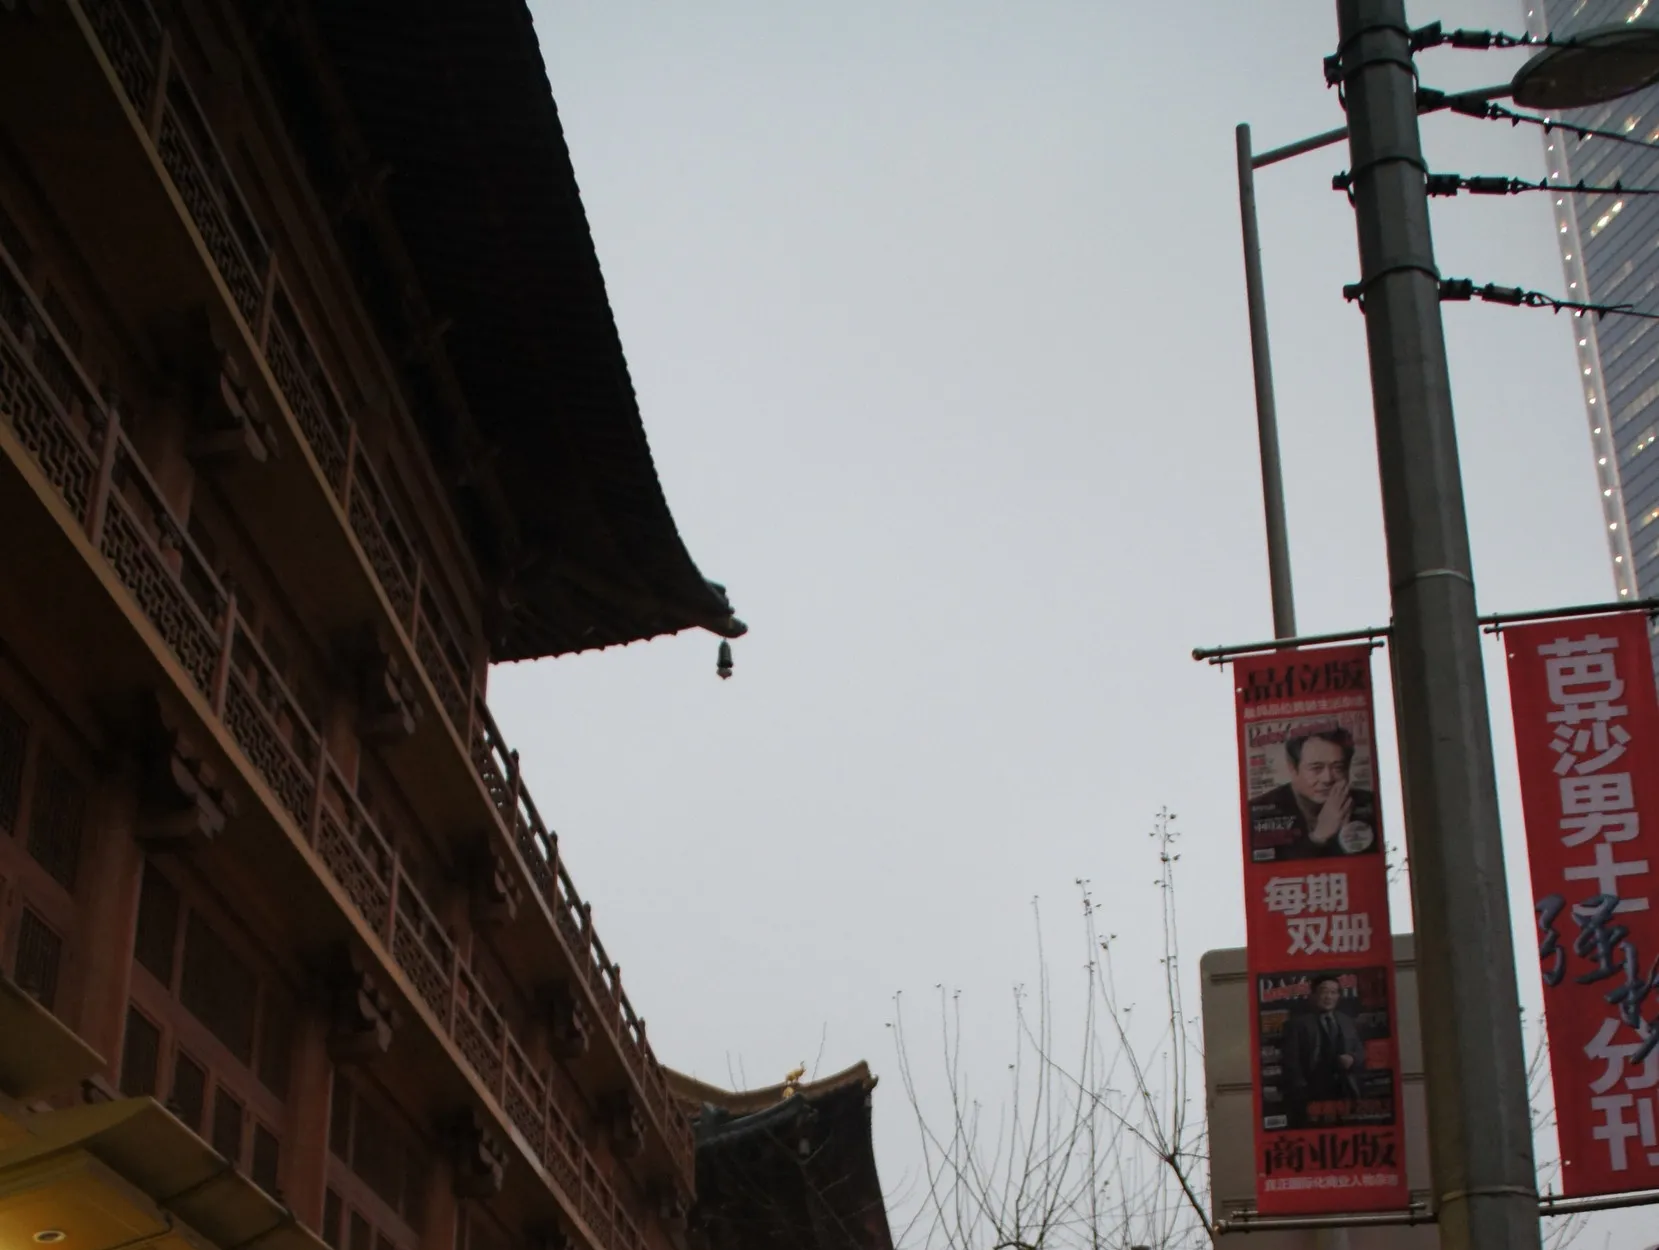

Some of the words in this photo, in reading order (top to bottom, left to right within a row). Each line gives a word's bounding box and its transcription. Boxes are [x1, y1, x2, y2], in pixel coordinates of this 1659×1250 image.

[1537, 633, 1651, 919] 芭莎男士
[1264, 872, 1349, 915] 每期
[1286, 912, 1373, 956] 双册
[1584, 1017, 1659, 1171] 分刊
[1260, 1131, 1397, 1177] 商业版
